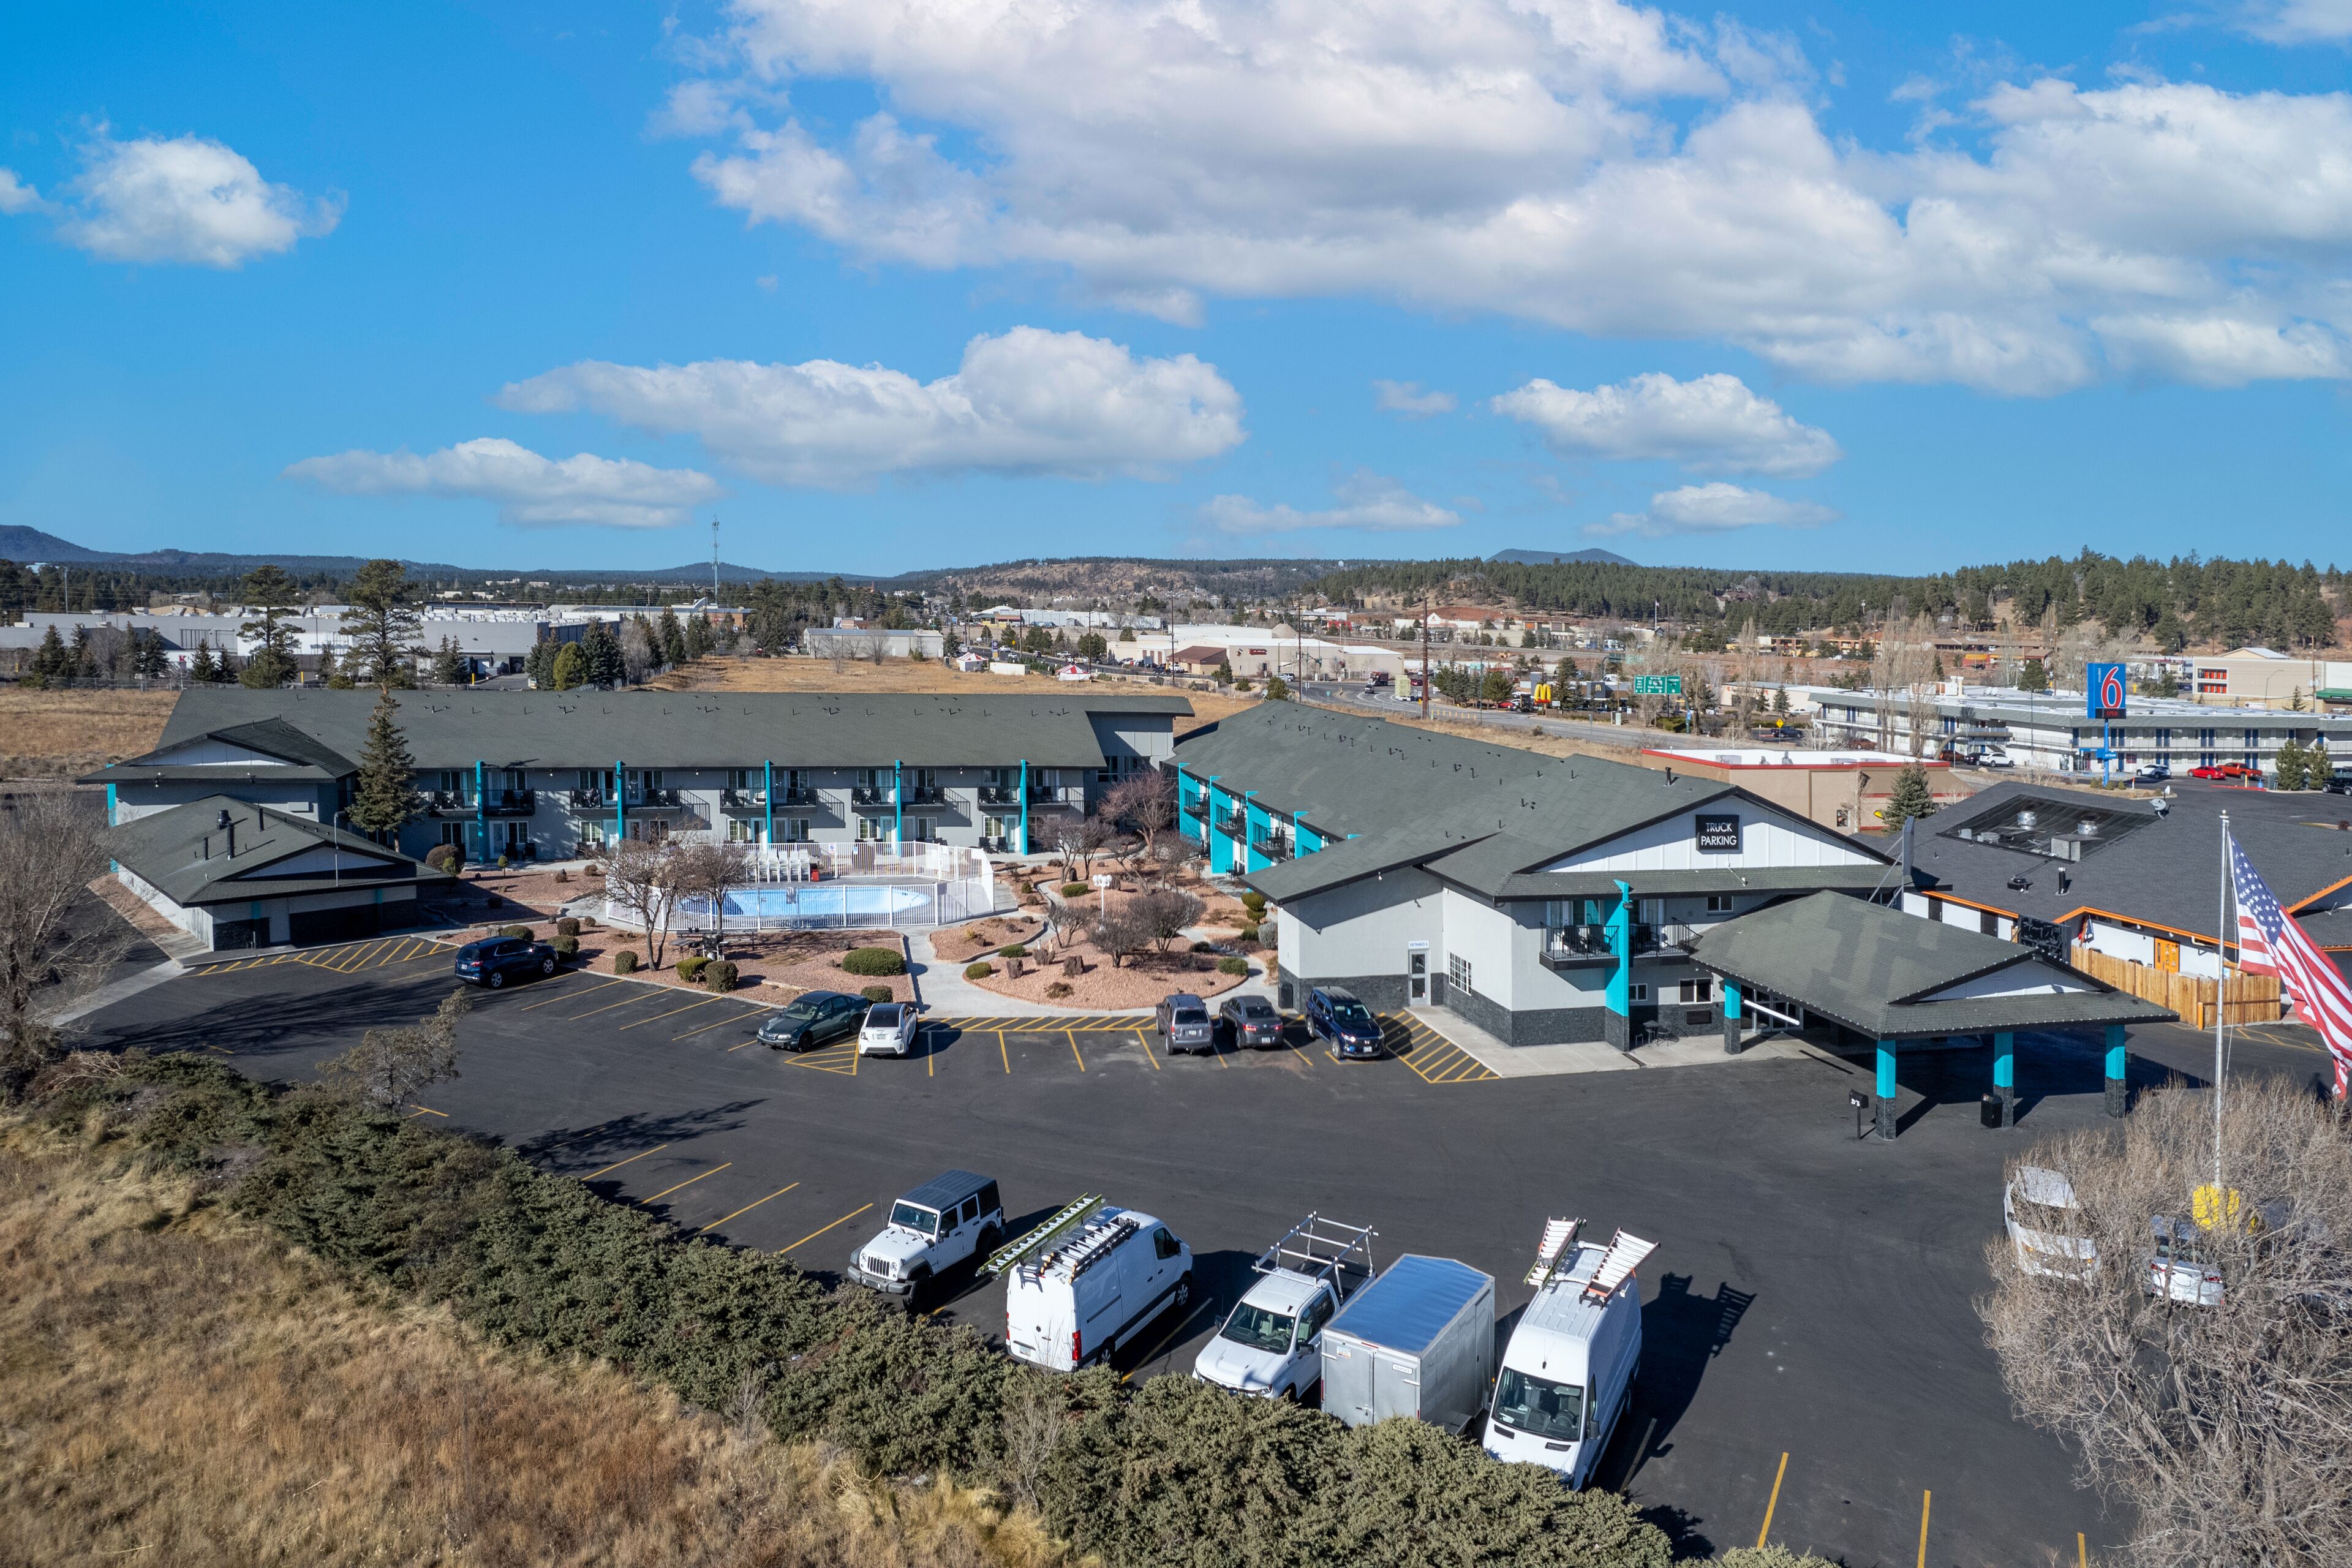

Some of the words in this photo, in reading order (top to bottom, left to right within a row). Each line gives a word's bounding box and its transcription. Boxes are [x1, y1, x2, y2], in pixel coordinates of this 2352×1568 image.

[2101, 666, 2122, 708] 6
[1706, 823, 1732, 832] TRUCK
[1701, 835, 1736, 846] PARKING
